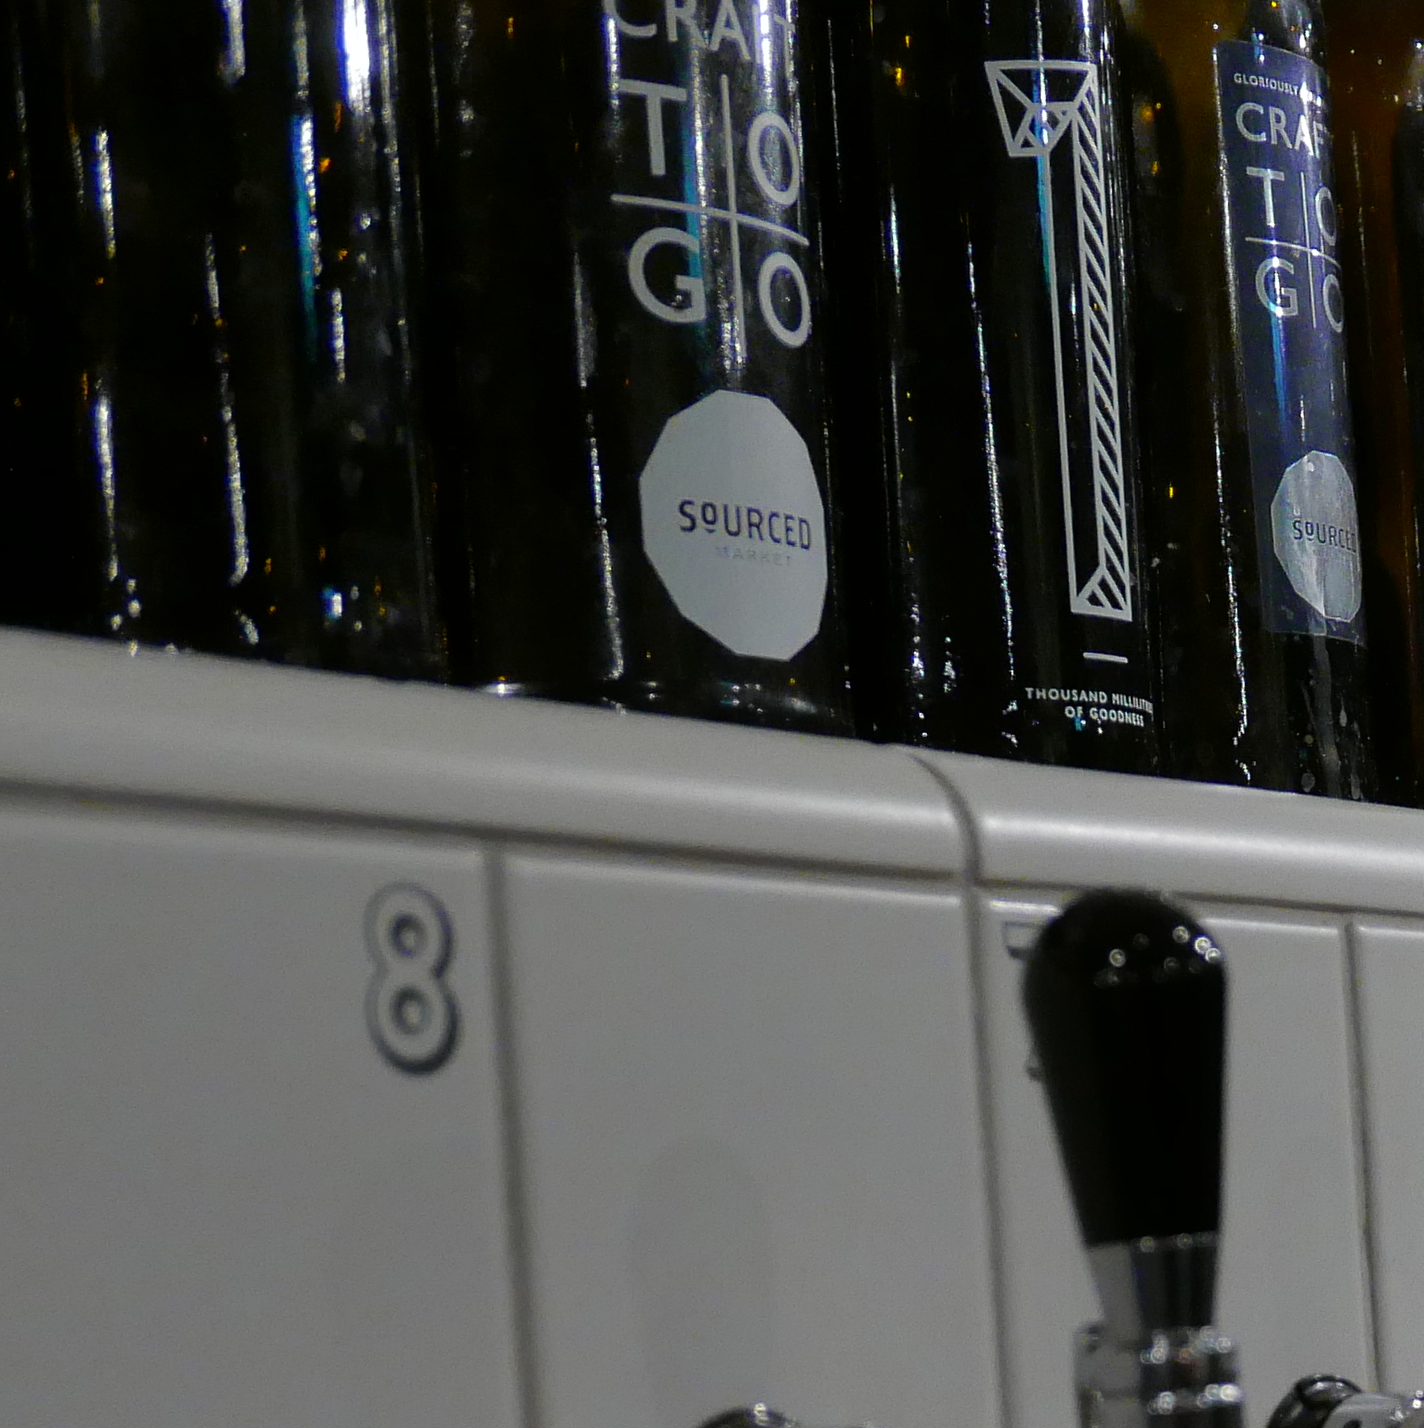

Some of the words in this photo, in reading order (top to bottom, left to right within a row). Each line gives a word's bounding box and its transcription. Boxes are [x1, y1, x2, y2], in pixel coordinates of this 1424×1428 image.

[1236, 102, 1331, 158] CRAF
[1025, 687, 1108, 704] THOUSAND
[1064, 706, 1083, 718] OF
[1089, 707, 1145, 727] GOODNESS
[364, 882, 459, 1074] 8
